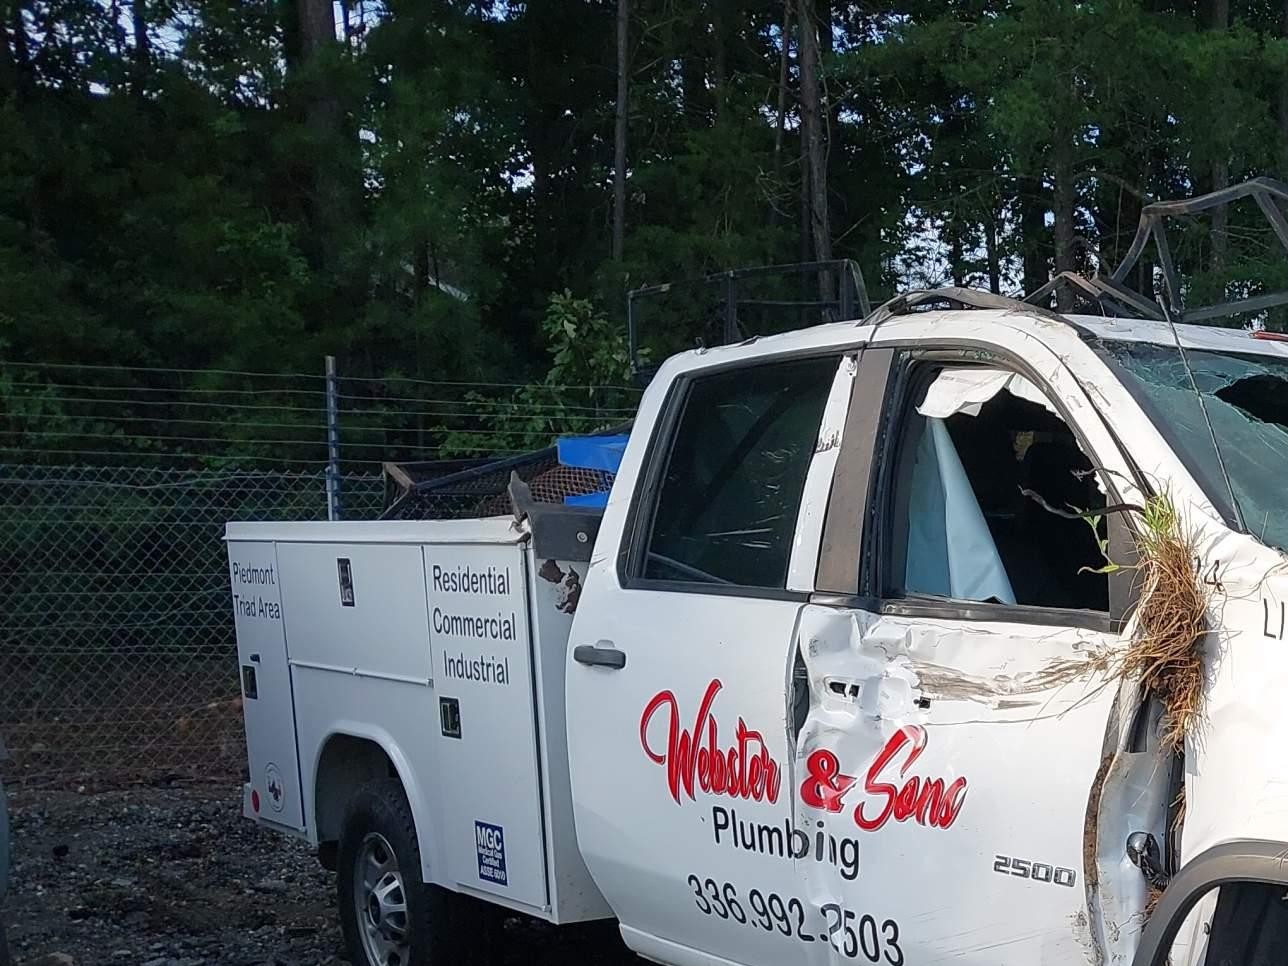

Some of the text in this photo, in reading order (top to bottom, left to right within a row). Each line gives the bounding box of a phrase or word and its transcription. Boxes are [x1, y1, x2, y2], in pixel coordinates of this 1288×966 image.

[232, 561, 276, 585] Piedmont
[432, 564, 511, 595] Residential
[233, 594, 281, 619] Triad Area
[433, 607, 517, 641] Commercial
[444, 650, 510, 685] Industrial
[639, 678, 969, 832] Webster & Sons
[476, 825, 502, 851] MGC
[712, 806, 860, 880] Plumbing
[993, 854, 1076, 888] 2500
